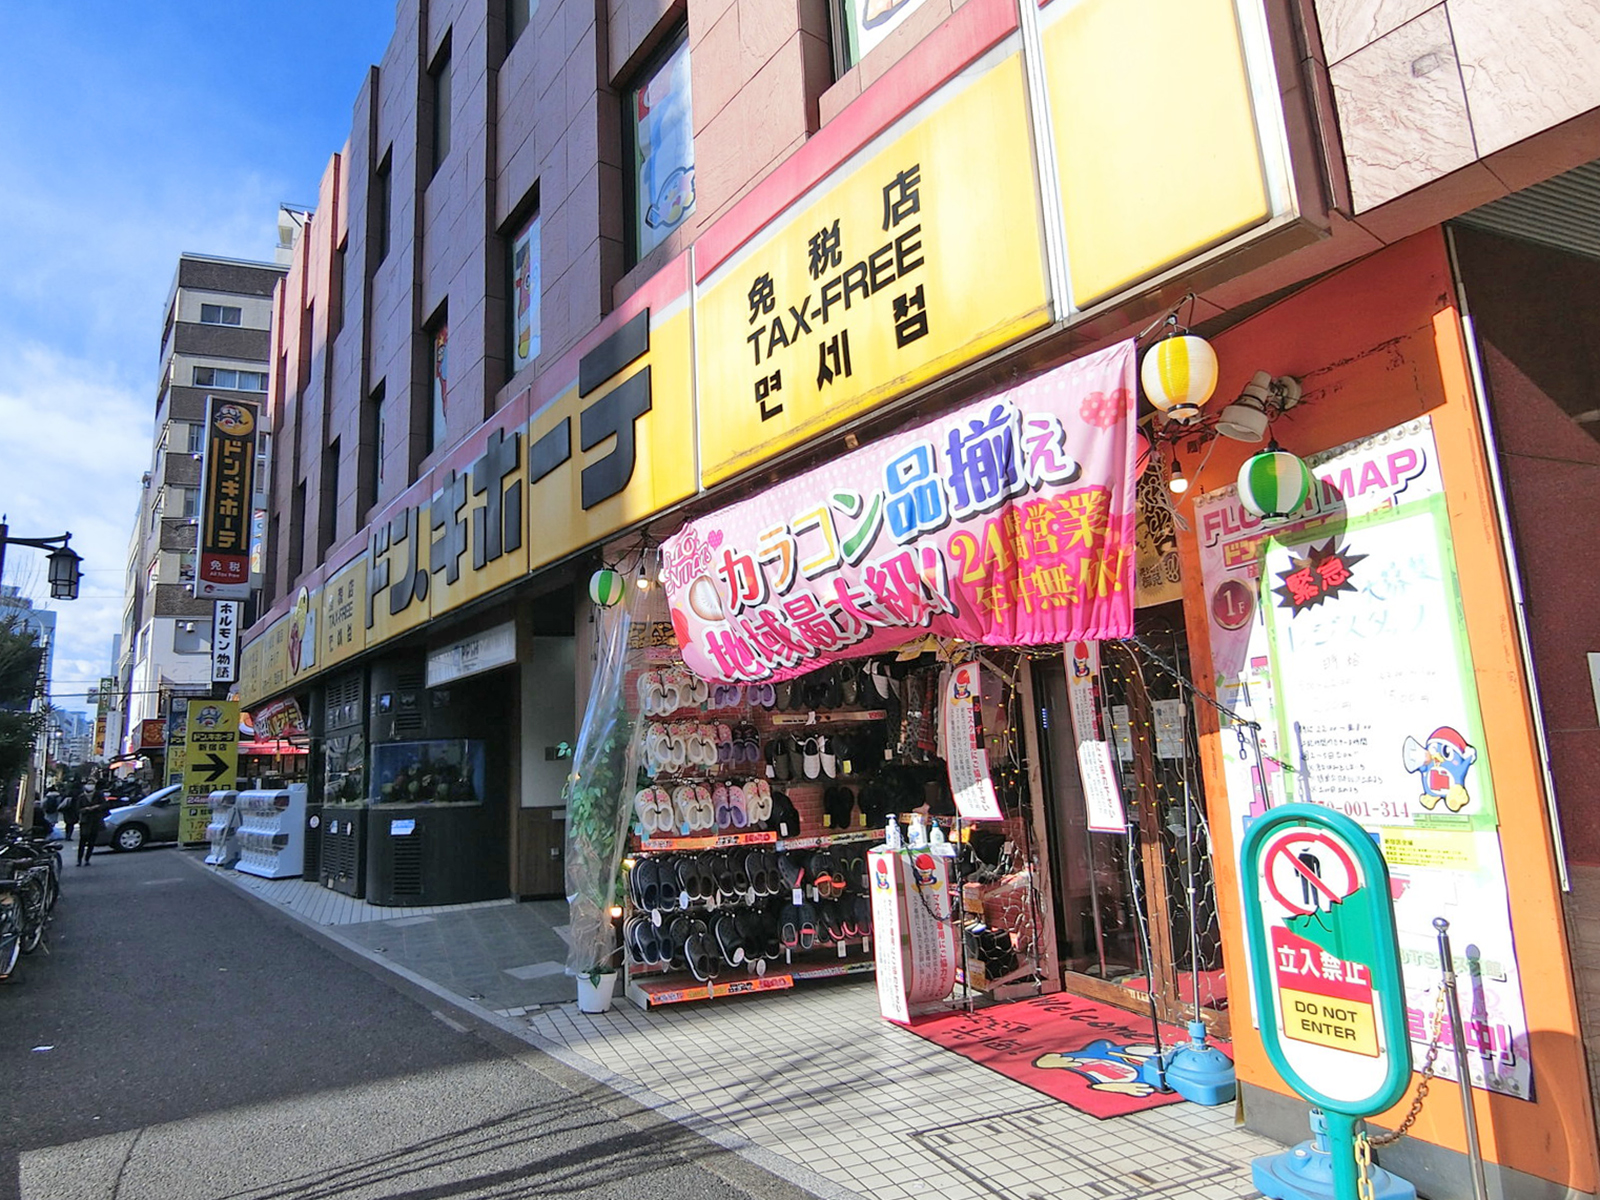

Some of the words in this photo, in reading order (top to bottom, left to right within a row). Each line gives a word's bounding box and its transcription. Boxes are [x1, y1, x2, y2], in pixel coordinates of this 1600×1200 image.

[748, 163, 921, 325] 免税店
[747, 224, 925, 366] TAX-FREE
[754, 283, 929, 422] 면세점
[717, 403, 1068, 609] カラコン品揃え
[1321, 448, 1418, 505] MAP
[950, 490, 1108, 585] 24時間営業
[1285, 555, 1351, 606] 緊急
[215, 602, 233, 679] ホルモン物語
[1276, 944, 1367, 986] 立入禁止
[1026, 995, 1153, 1040] Welcome
[1294, 1000, 1318, 1016] DO
[1322, 1005, 1358, 1023] NOT
[1300, 1018, 1357, 1041] ENTER
